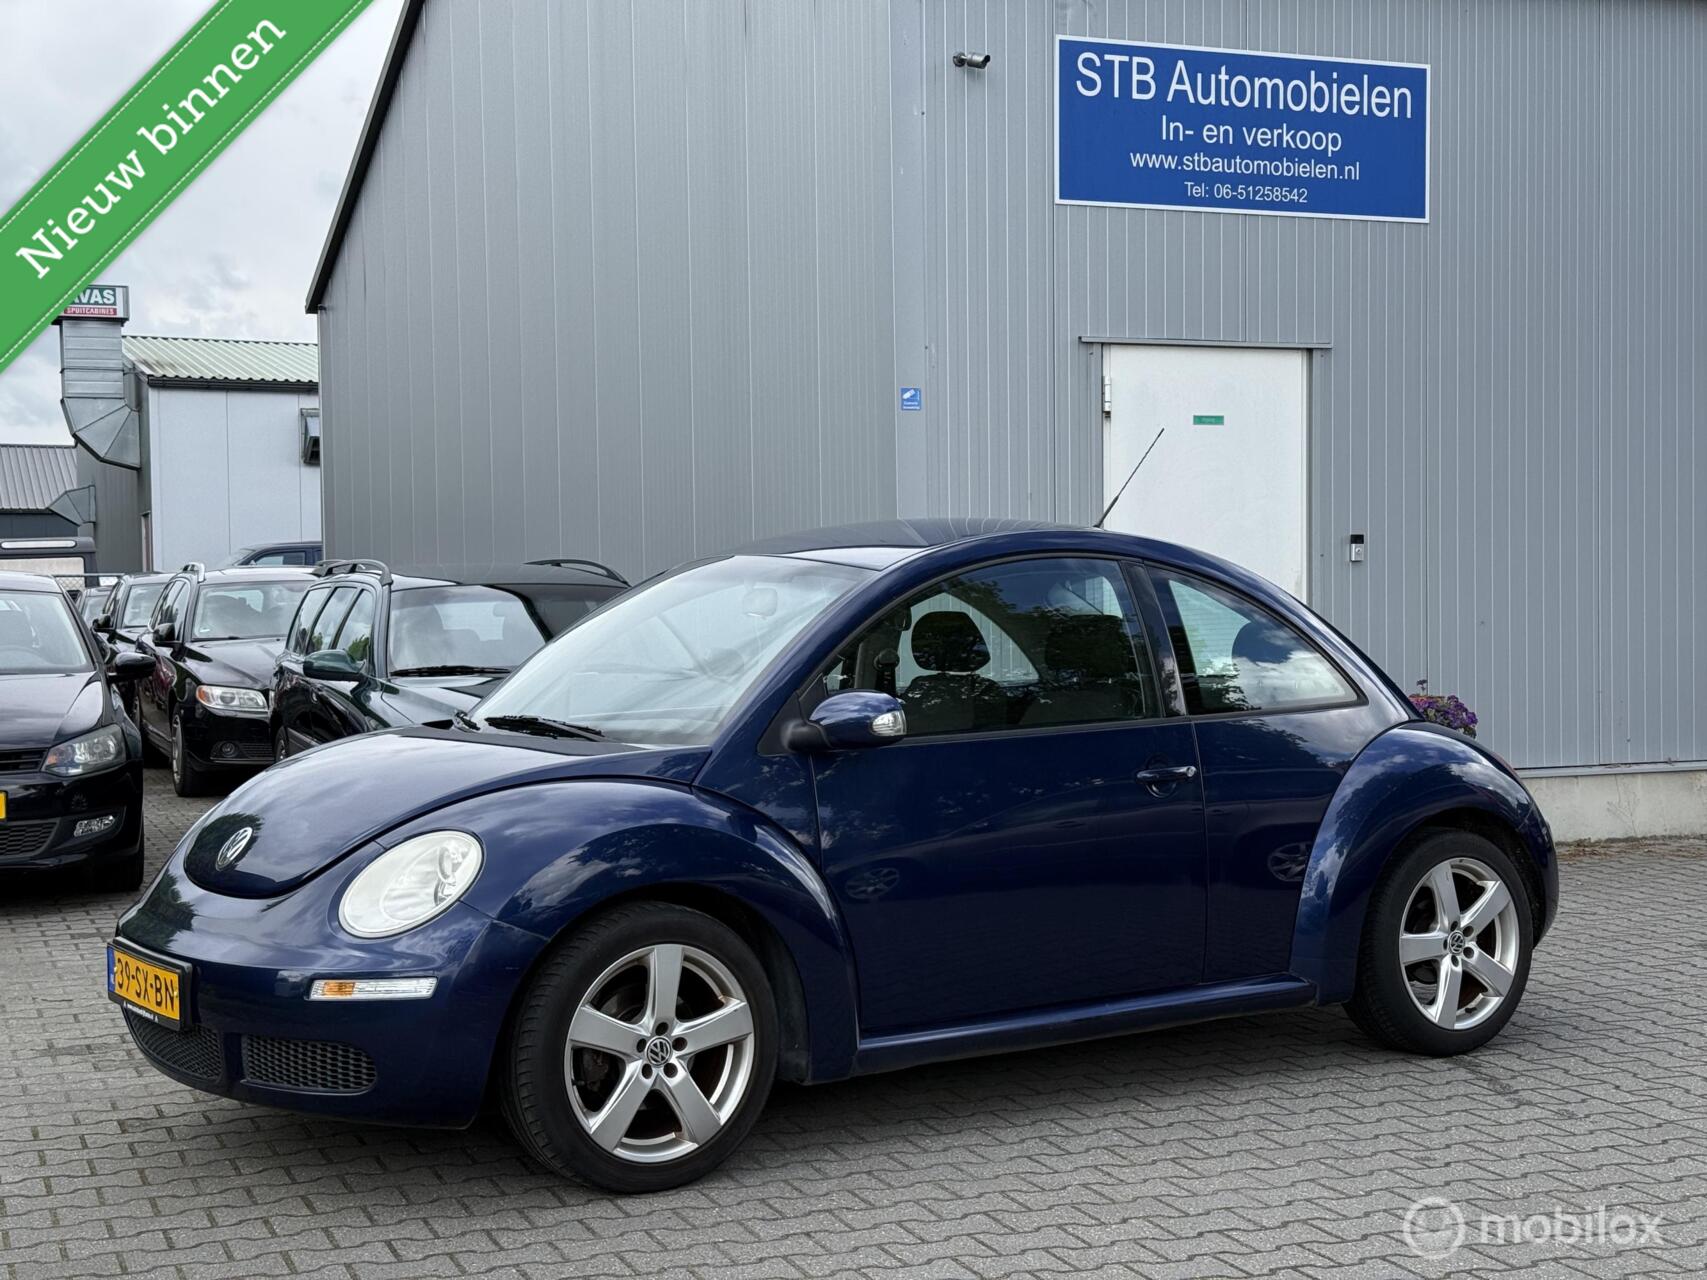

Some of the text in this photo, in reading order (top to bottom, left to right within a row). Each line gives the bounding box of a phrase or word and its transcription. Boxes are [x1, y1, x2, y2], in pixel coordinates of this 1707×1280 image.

[1076, 51, 1412, 119] STB Automobielen
[1162, 115, 1342, 157] In- en verkoop
[1130, 152, 1360, 181] www.stbautomobielen.nl
[1184, 181, 1308, 203] Tel: 06-51258542
[73, 288, 115, 304] VAS
[117, 957, 175, 1012] 39-SX-BN
